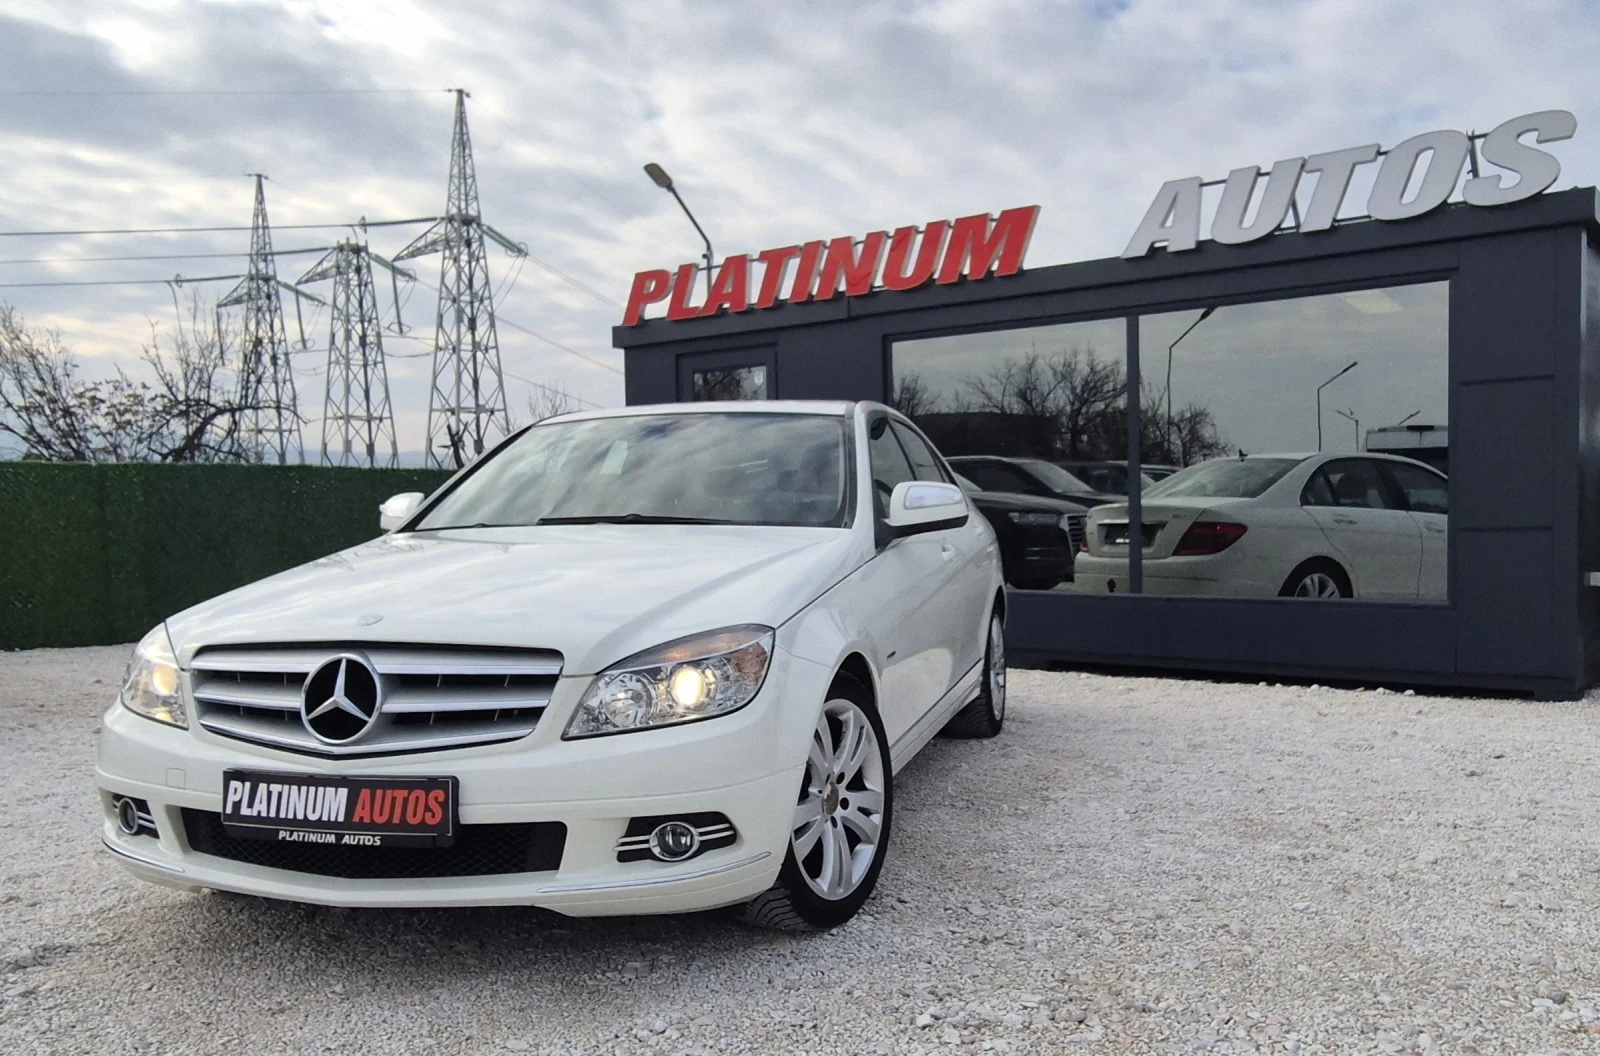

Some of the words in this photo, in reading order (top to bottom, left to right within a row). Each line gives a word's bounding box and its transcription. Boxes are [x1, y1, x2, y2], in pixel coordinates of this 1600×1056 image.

[621, 204, 1041, 327] PLATINUM
[1120, 109, 1578, 260] AUTOS
[225, 779, 349, 822] PLATINUM
[352, 788, 446, 825] AUTOS
[278, 830, 336, 844] PLATINUM
[341, 833, 381, 846] AUTOS
